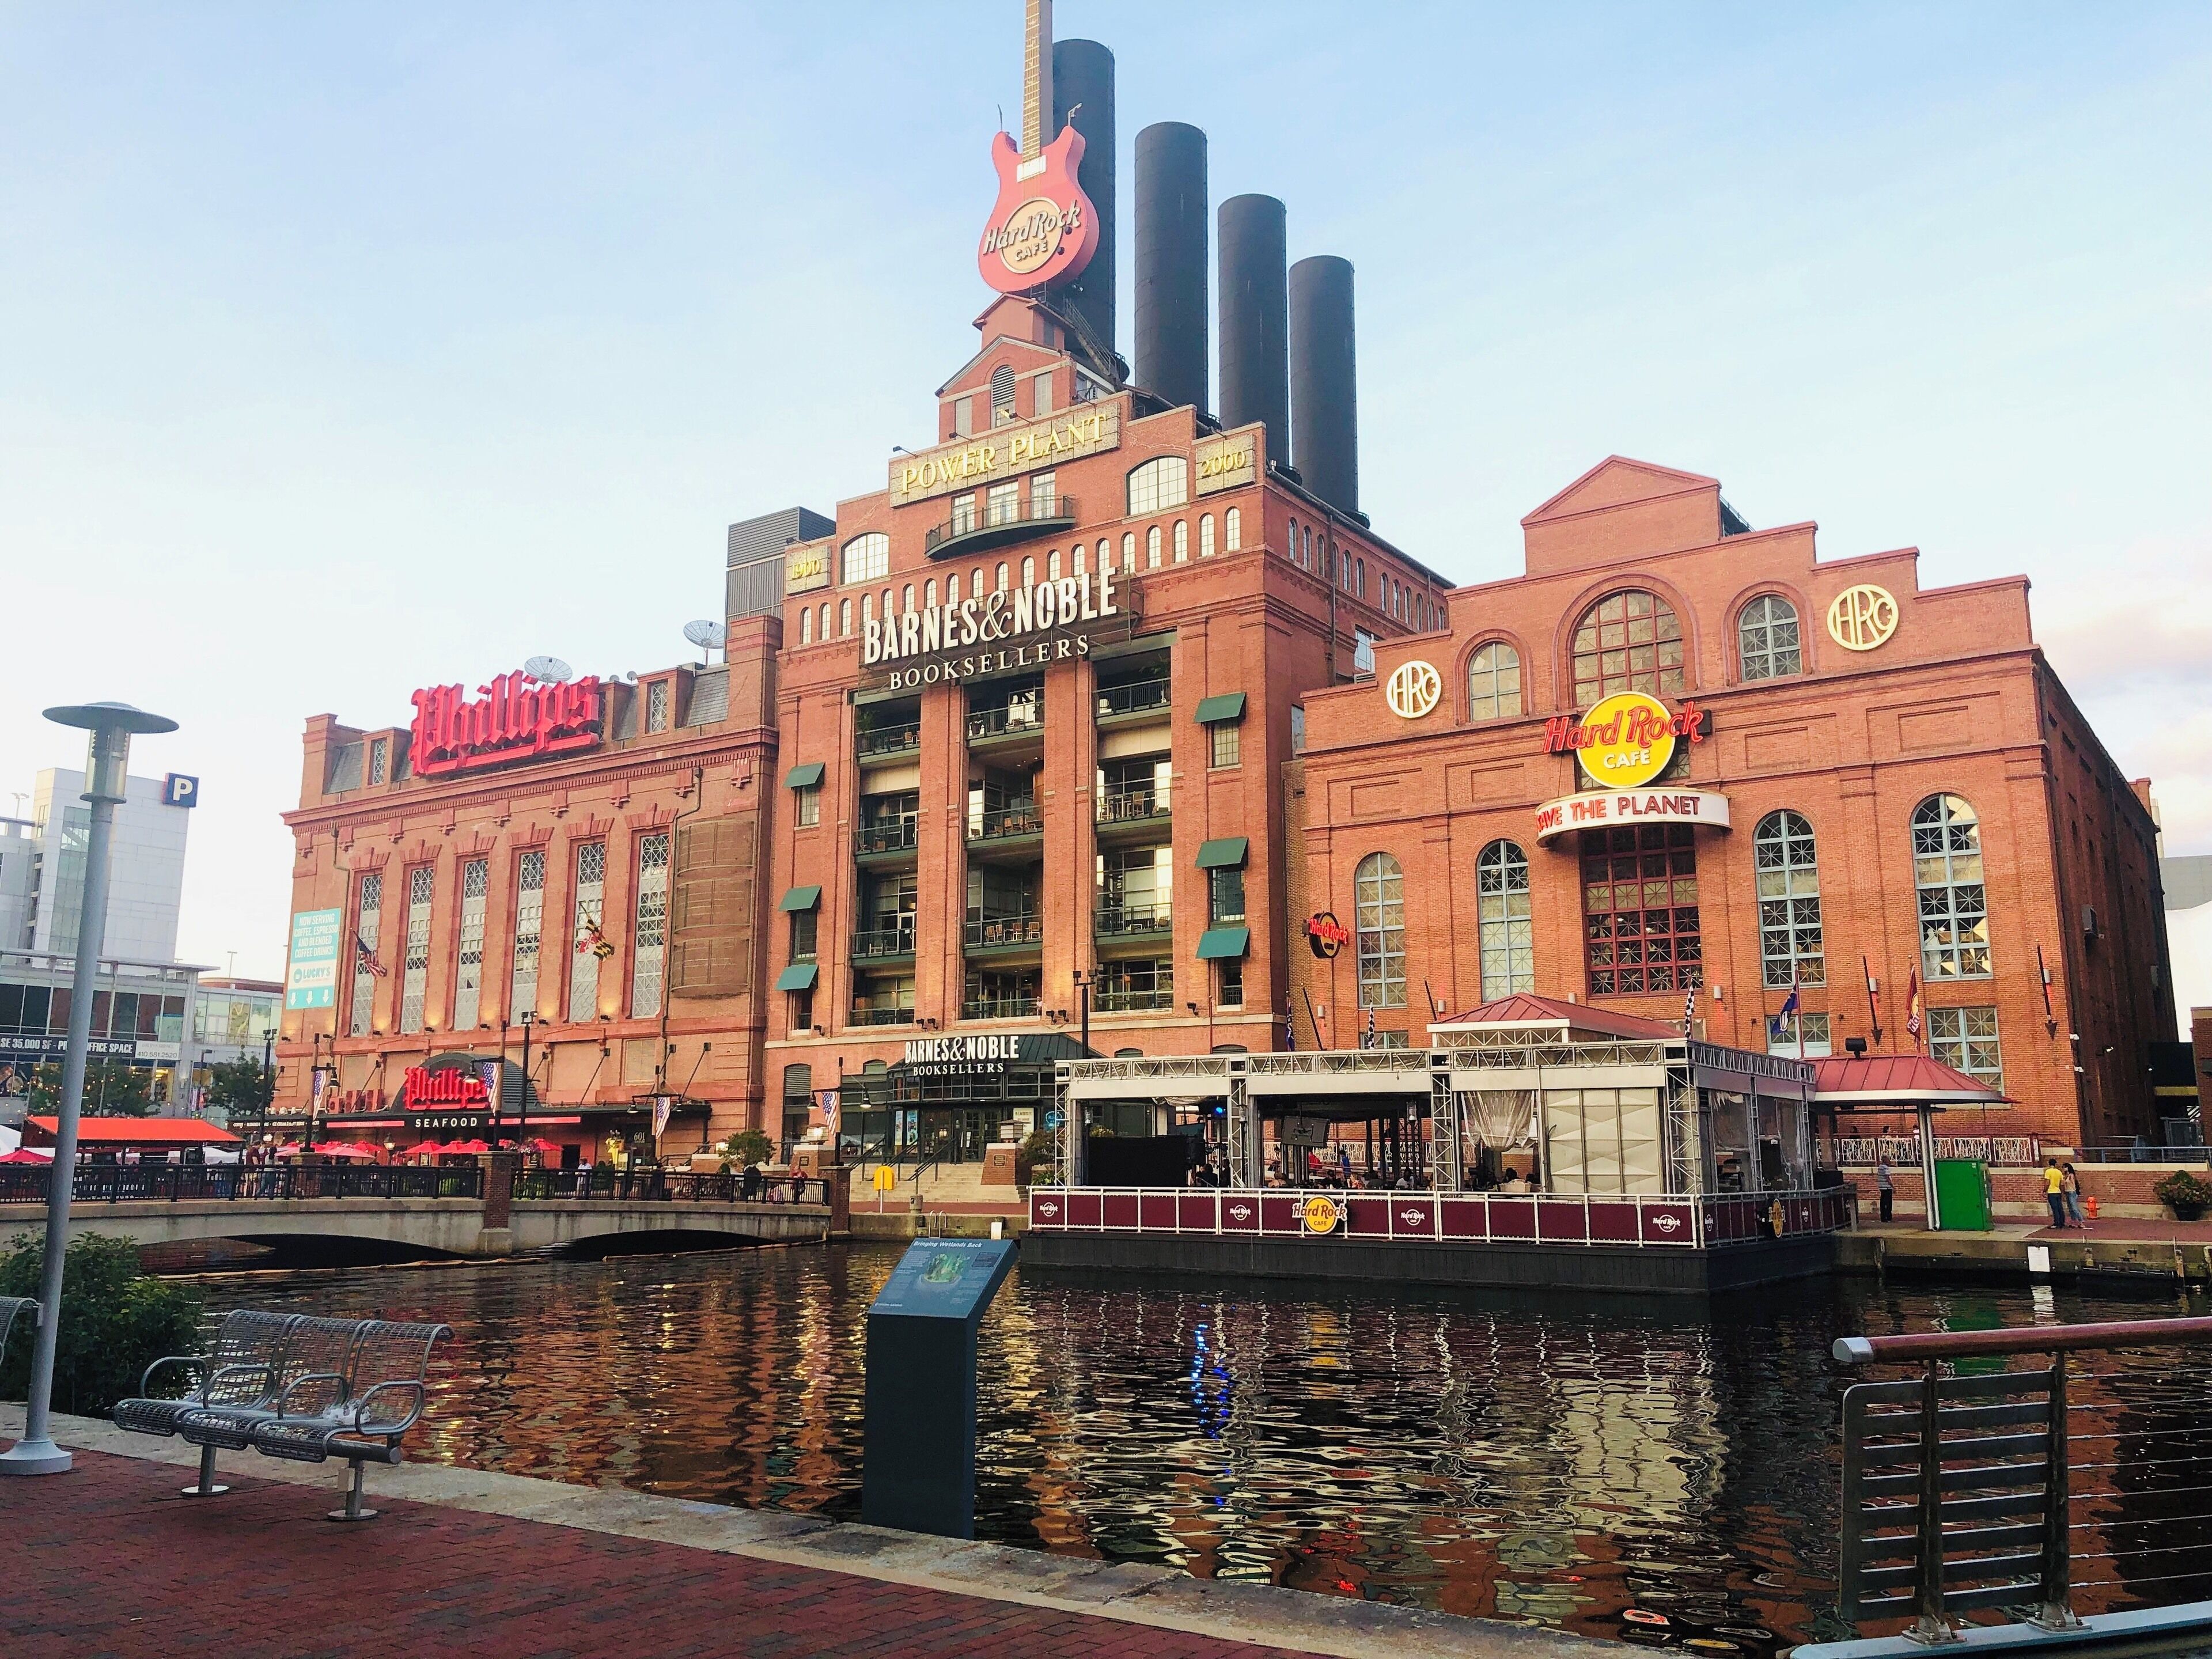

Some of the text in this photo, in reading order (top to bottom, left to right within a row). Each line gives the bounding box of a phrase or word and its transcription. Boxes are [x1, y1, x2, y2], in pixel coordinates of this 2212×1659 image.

[983, 200, 1081, 256] Hard Rock
[1015, 240, 1048, 261] CAFE
[902, 414, 1107, 494] POWER PLANT
[1202, 451, 1245, 476] 2000
[889, 634, 1090, 690] BOOKSELLERS
[408, 669, 600, 776] Phillips
[1543, 701, 1703, 752] Hard Rock
[1604, 749, 1650, 769] CAFE
[173, 778, 193, 801] P
[1570, 799, 1607, 820] THE
[1618, 796, 1700, 815] PLANET
[299, 913, 335, 926] NOW SERVING
[1309, 918, 1347, 944] Hard Rock
[298, 935, 332, 948] AND BLENDED
[295, 948, 313, 958] COFFEE
[0, 1038, 11, 1048] SE
[12, 1039, 40, 1049] 35,000
[41, 1040, 52, 1050] SF
[109, 1043, 133, 1054] SPACE
[913, 1063, 1003, 1076] BOOKSELLERS
[415, 1118, 478, 1128] SEAFOOD
[634, 1132, 645, 1141] 601
[1292, 1203, 1347, 1220] Hard Rock
[1667, 1218, 1680, 1226] Rock
